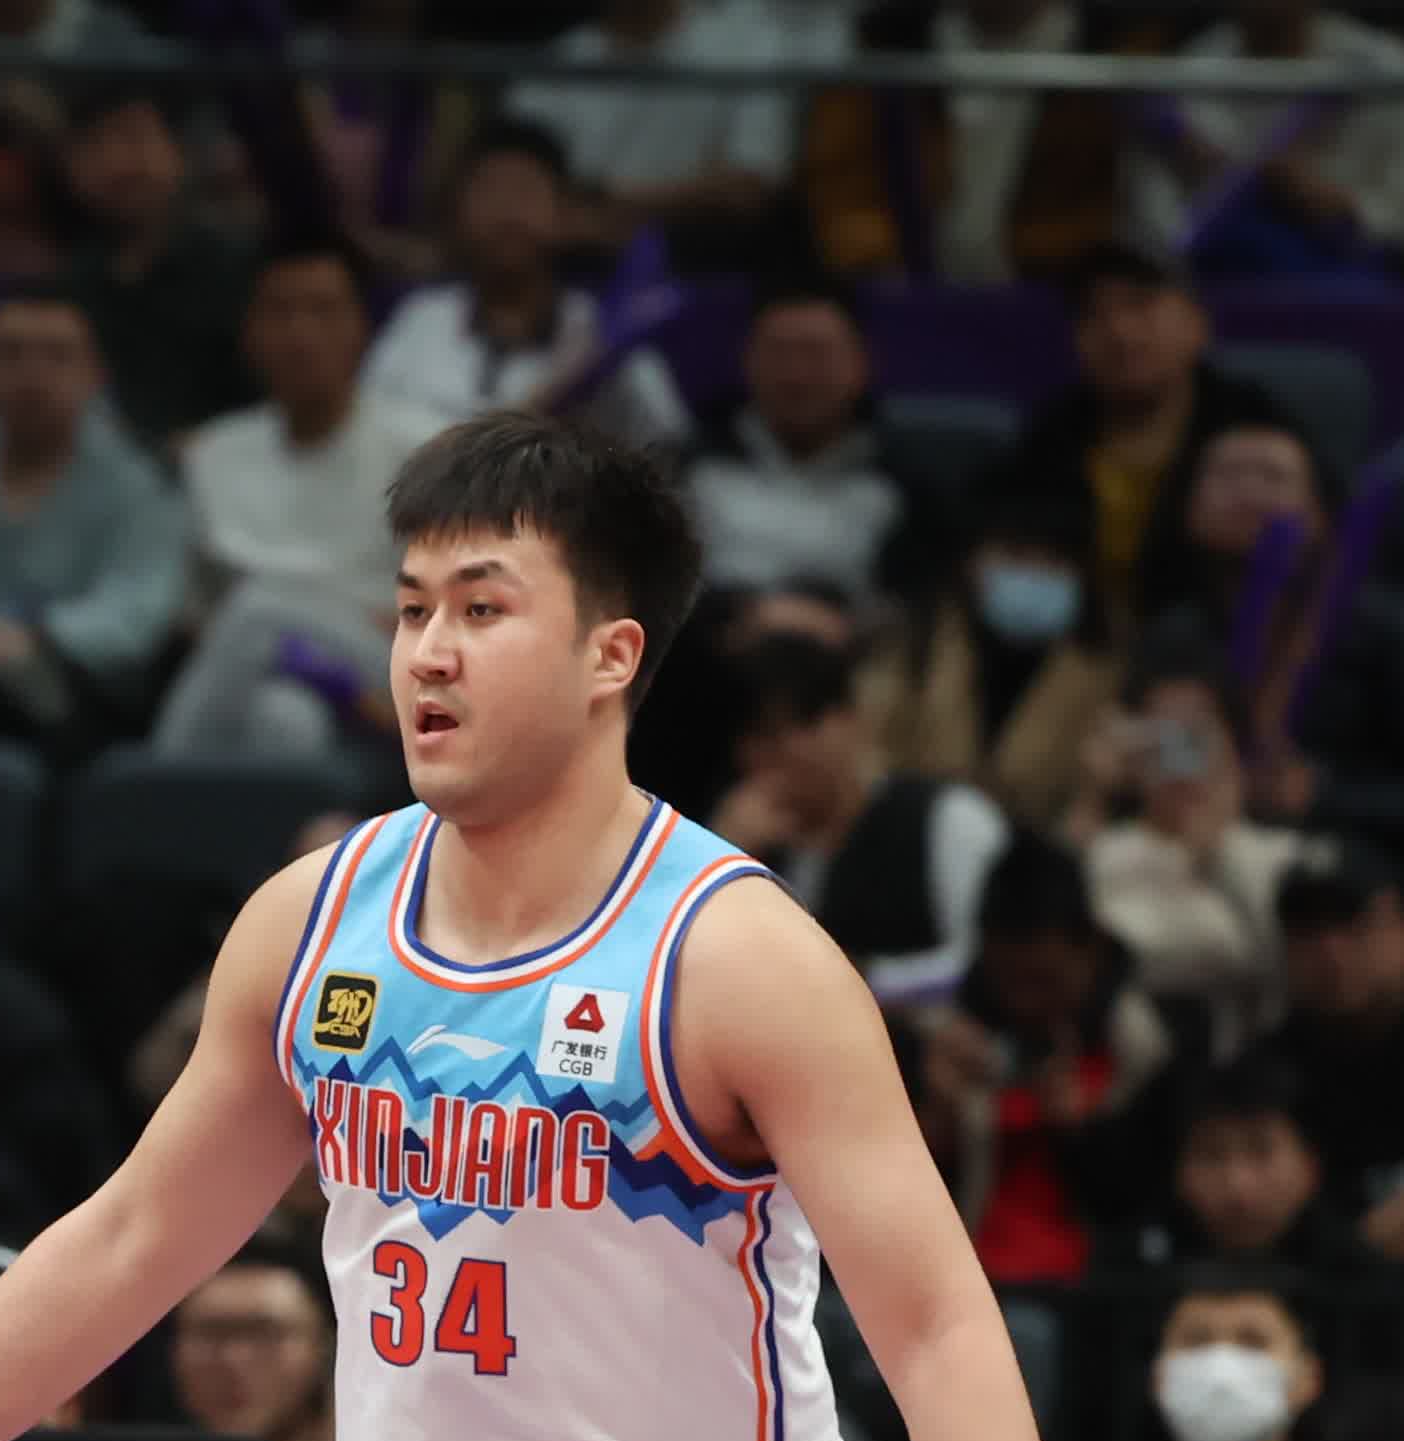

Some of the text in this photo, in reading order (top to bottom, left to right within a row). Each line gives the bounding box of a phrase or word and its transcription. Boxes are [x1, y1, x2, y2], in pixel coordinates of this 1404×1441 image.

[551, 1040, 608, 1060] 广发银行
[558, 1058, 593, 1077] CGB
[312, 1075, 610, 1212] XINJIANG
[370, 1239, 517, 1376] 34
